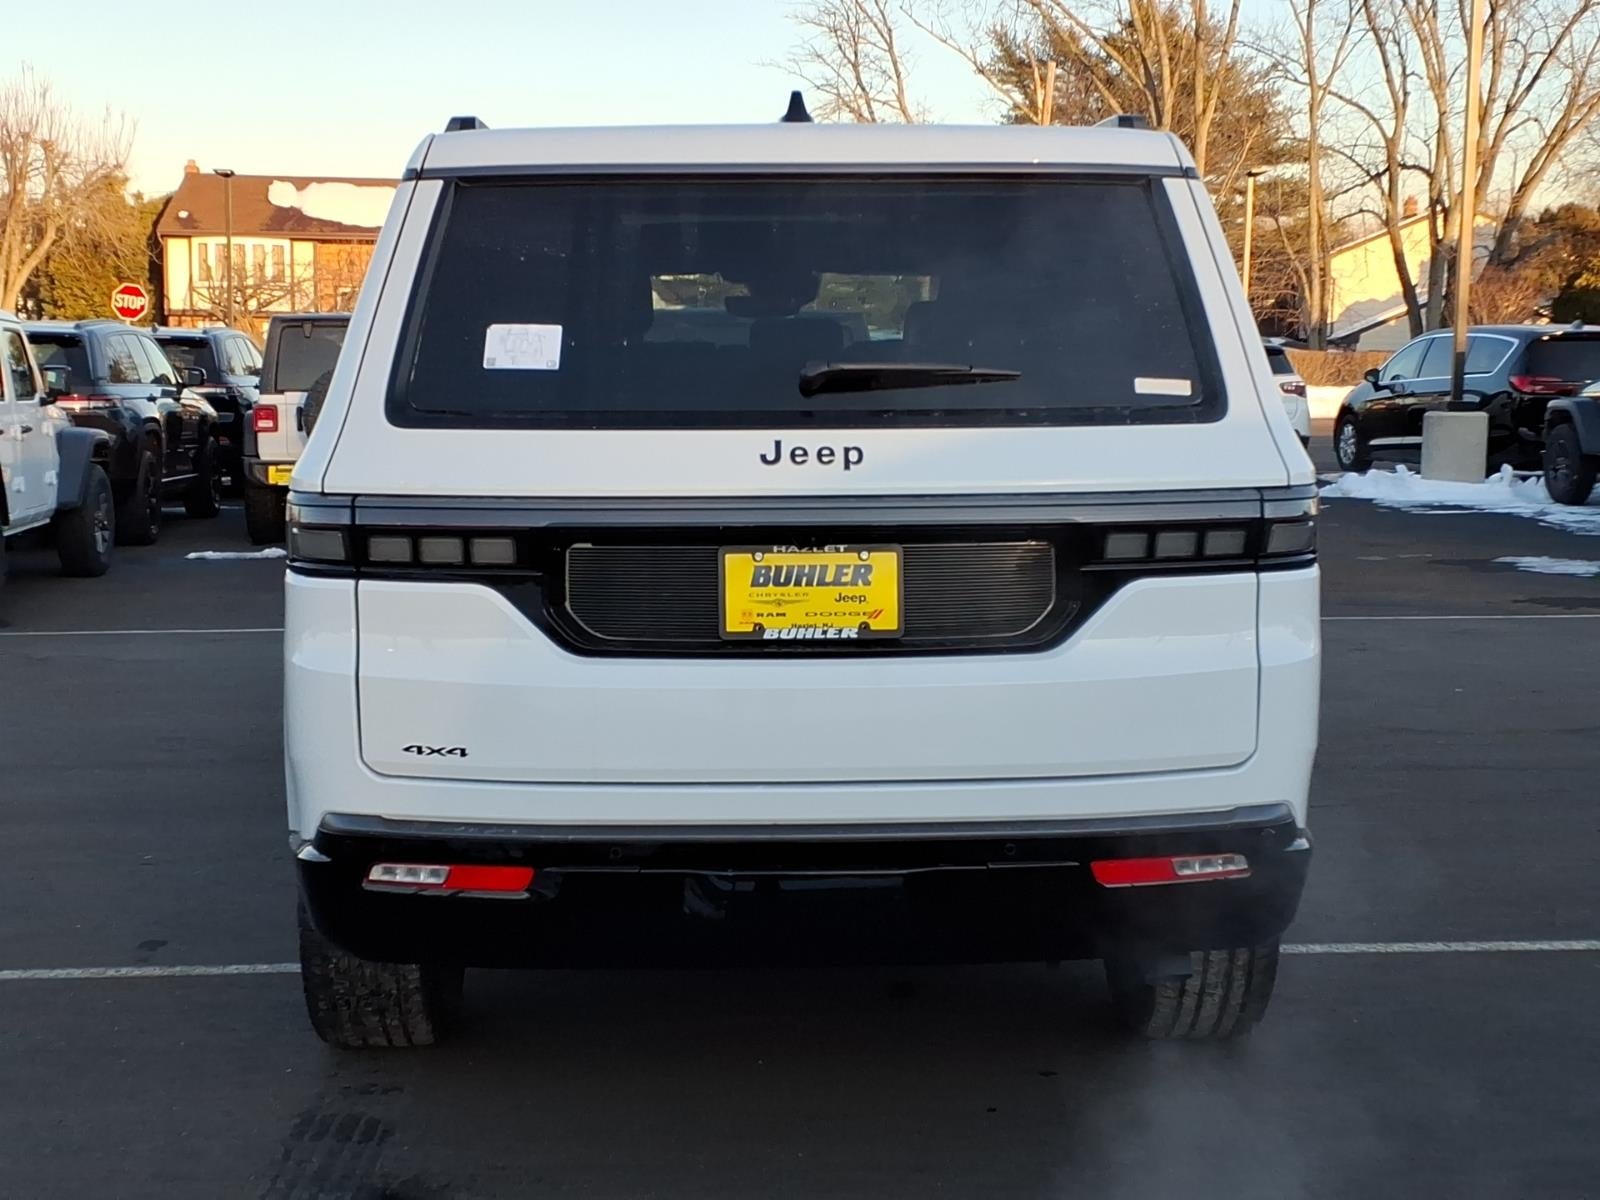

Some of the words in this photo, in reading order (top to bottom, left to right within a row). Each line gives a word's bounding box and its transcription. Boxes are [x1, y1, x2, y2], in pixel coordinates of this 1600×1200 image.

[114, 294, 145, 310] STOP
[760, 440, 864, 471] Jeep
[751, 563, 873, 587] BUHLER
[834, 592, 867, 604] Jeep
[763, 627, 858, 640] BUHLER
